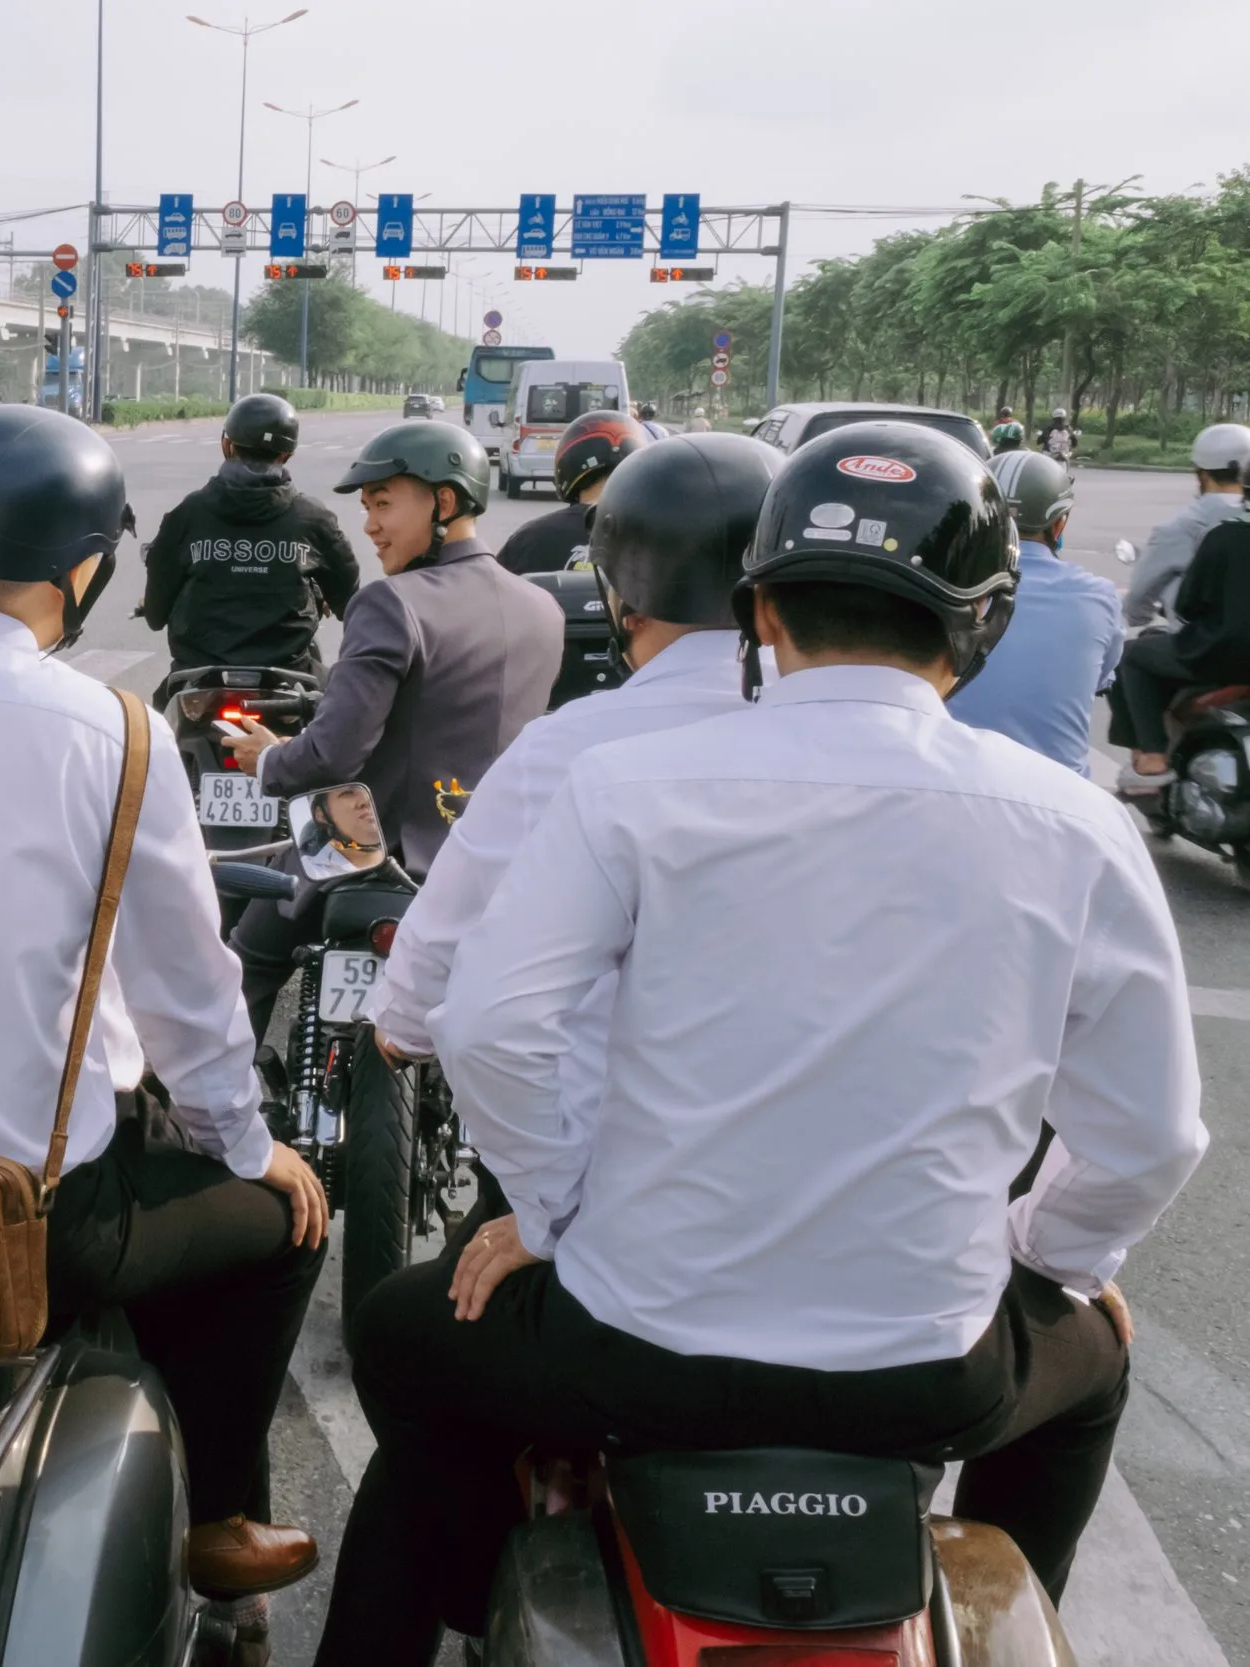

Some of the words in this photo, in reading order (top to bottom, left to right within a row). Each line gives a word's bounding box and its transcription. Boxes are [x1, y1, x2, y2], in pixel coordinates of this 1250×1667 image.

[229, 208, 241, 219] 80
[336, 208, 349, 219] 60
[206, 801, 273, 823] 426.30
[703, 1492, 868, 1517] PIAGGIO
